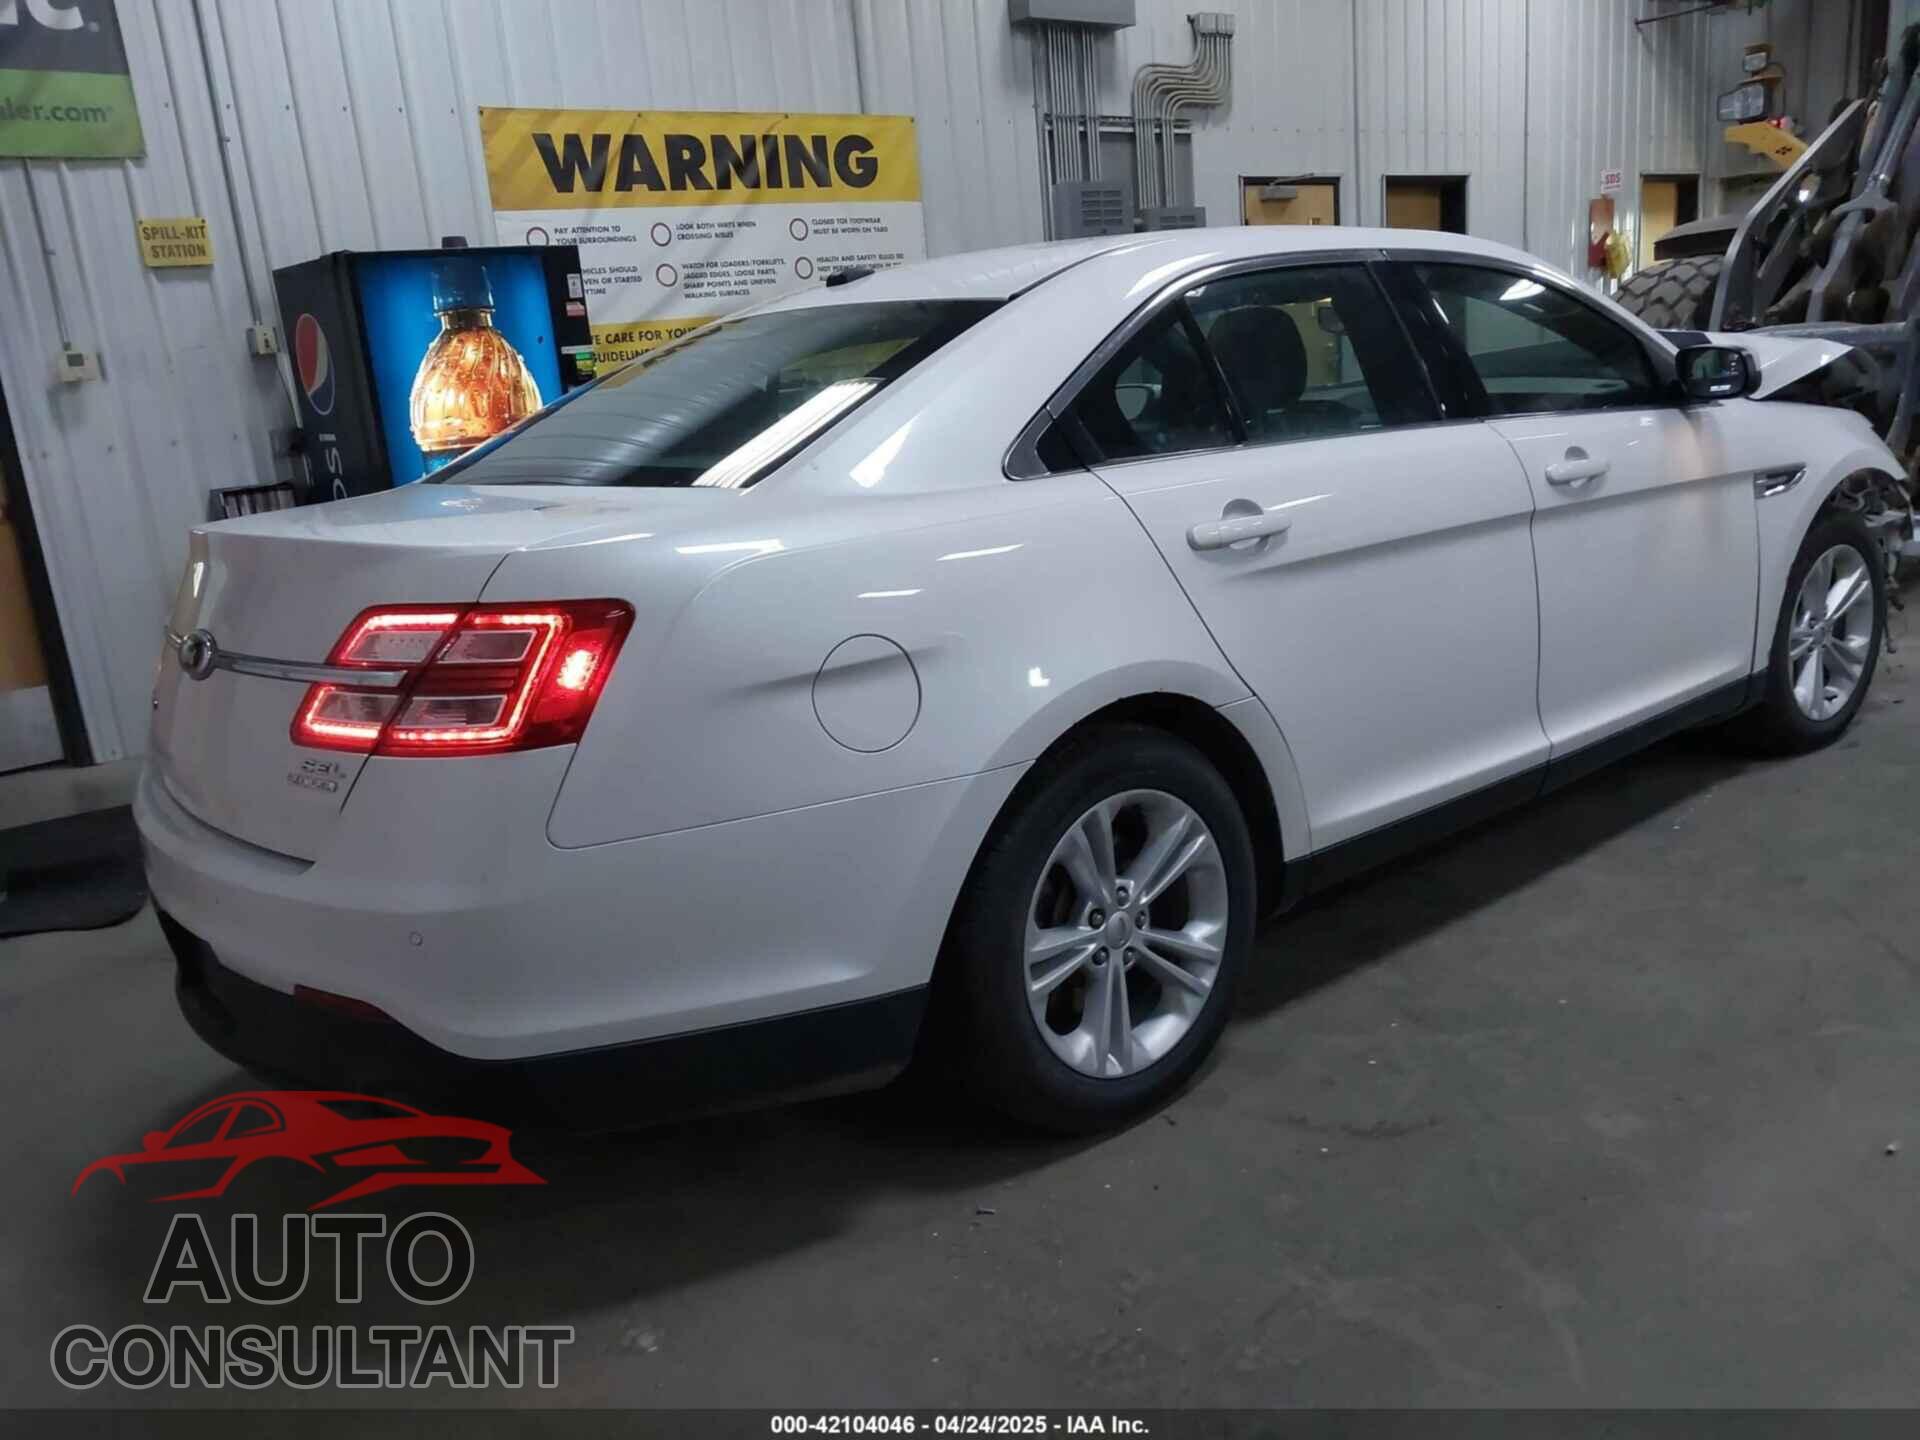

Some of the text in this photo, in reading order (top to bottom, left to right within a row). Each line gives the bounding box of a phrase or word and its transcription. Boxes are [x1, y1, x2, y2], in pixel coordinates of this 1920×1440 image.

[532, 133, 878, 193] WARNING
[849, 216, 880, 224] FOOTWEAR
[142, 225, 206, 241] SPILL-KIT
[571, 225, 609, 234] ATTENTION
[611, 225, 621, 233] TO
[578, 235, 637, 244] SURROUNDINGS
[152, 243, 206, 258] STATION
[684, 291, 717, 299] WALKING
[605, 333, 634, 345] CARE
[637, 330, 663, 341] FOR
